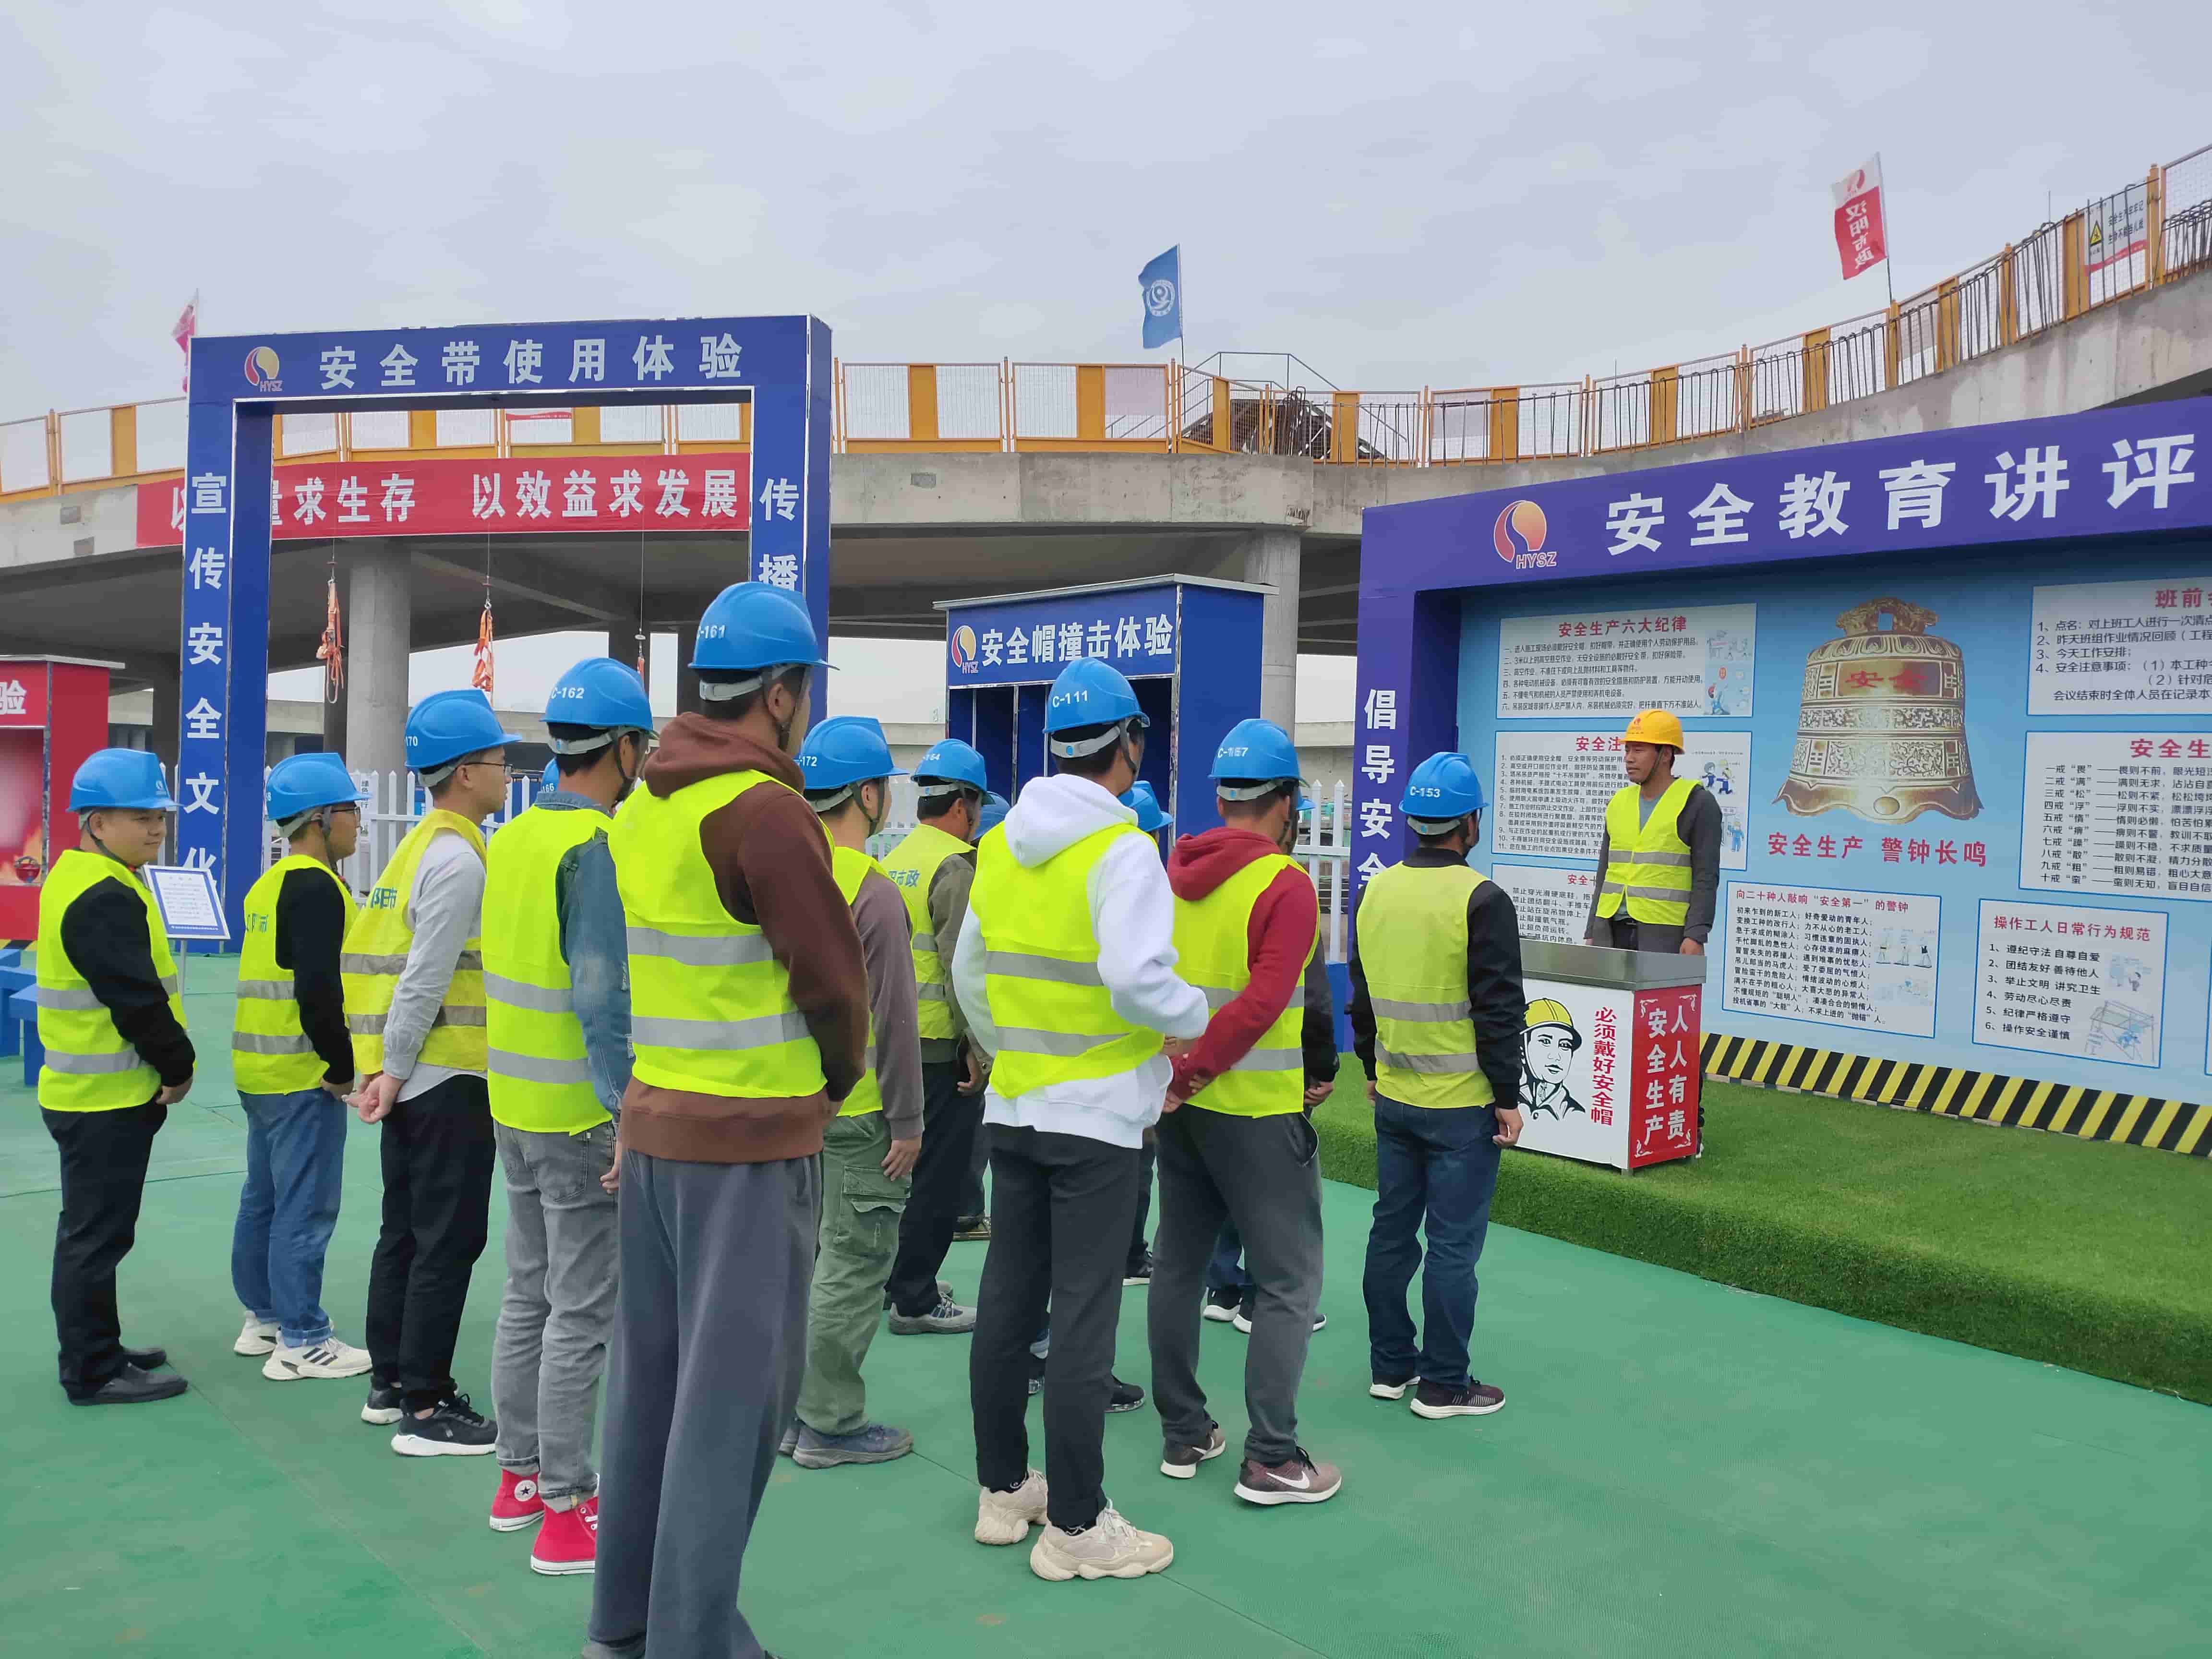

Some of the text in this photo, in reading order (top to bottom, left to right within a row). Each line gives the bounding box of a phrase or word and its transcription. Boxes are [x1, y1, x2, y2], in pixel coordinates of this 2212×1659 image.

[320, 333, 742, 389] 安全带使用体验
[260, 381, 283, 392] HYSZ
[472, 469, 737, 520] 以效益求发展
[1607, 433, 2195, 556] 安全教育讲评
[1516, 552, 1556, 569] HYSZ
[1559, 616, 1686, 637] 安全生产六大纪律
[982, 614, 1173, 666] 安全帽撞击体验
[962, 661, 979, 673] HYSZ
[551, 687, 584, 699] C-162
[1053, 691, 1088, 707] C-111
[1576, 736, 1622, 751] 安全注
[1410, 762, 1440, 773] C-153
[1768, 832, 1986, 867] 安全生产 警钟长鸣
[1994, 915, 2151, 941] 操作工人日常行为规范
[1590, 1007, 1617, 1126] 必须戴好安全帽
[1644, 1008, 1667, 1146] 安全生产
[1668, 1005, 1689, 1141] 人人有责
